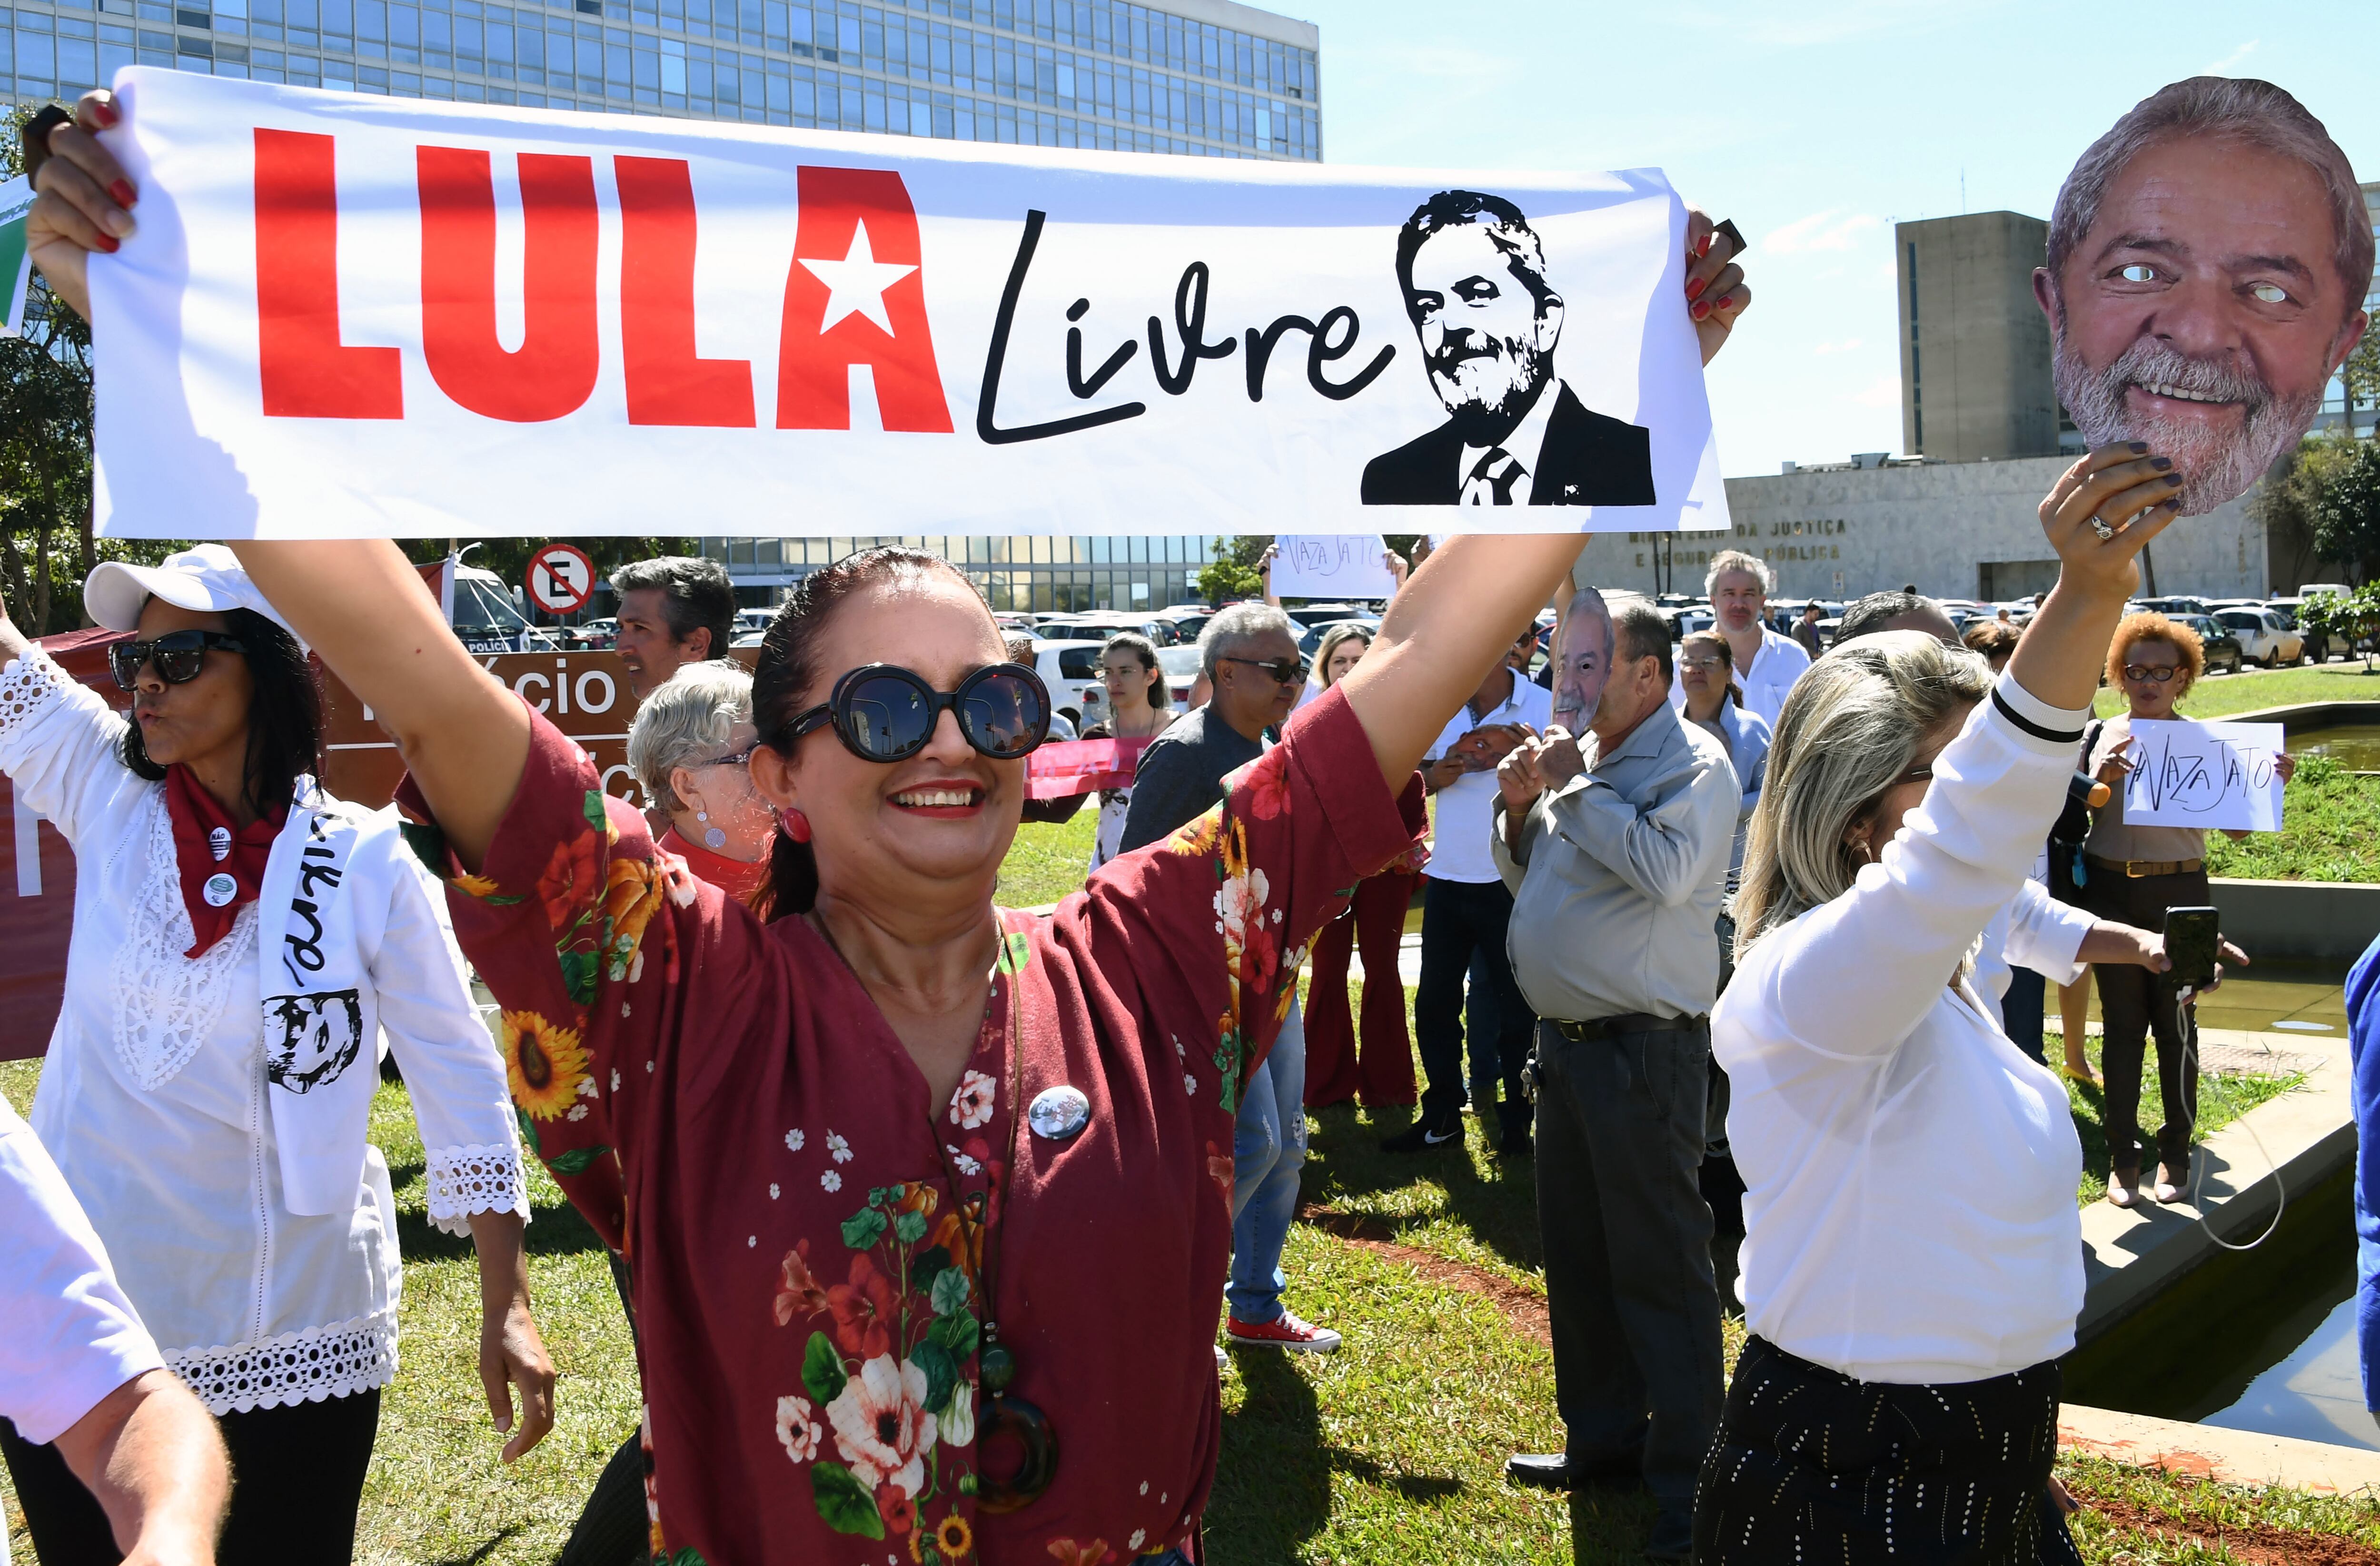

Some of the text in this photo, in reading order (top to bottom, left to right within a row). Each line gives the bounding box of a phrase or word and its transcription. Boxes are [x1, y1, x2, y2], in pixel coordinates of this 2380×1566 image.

[253, 127, 1397, 445] LULA Livre
[1736, 524, 1758, 537] DA
[1771, 519, 1846, 536] JUSTIÇA
[1636, 553, 1644, 567] E
[1764, 544, 1840, 562] PÚBLICA
[468, 641, 512, 653] POLÍCIA
